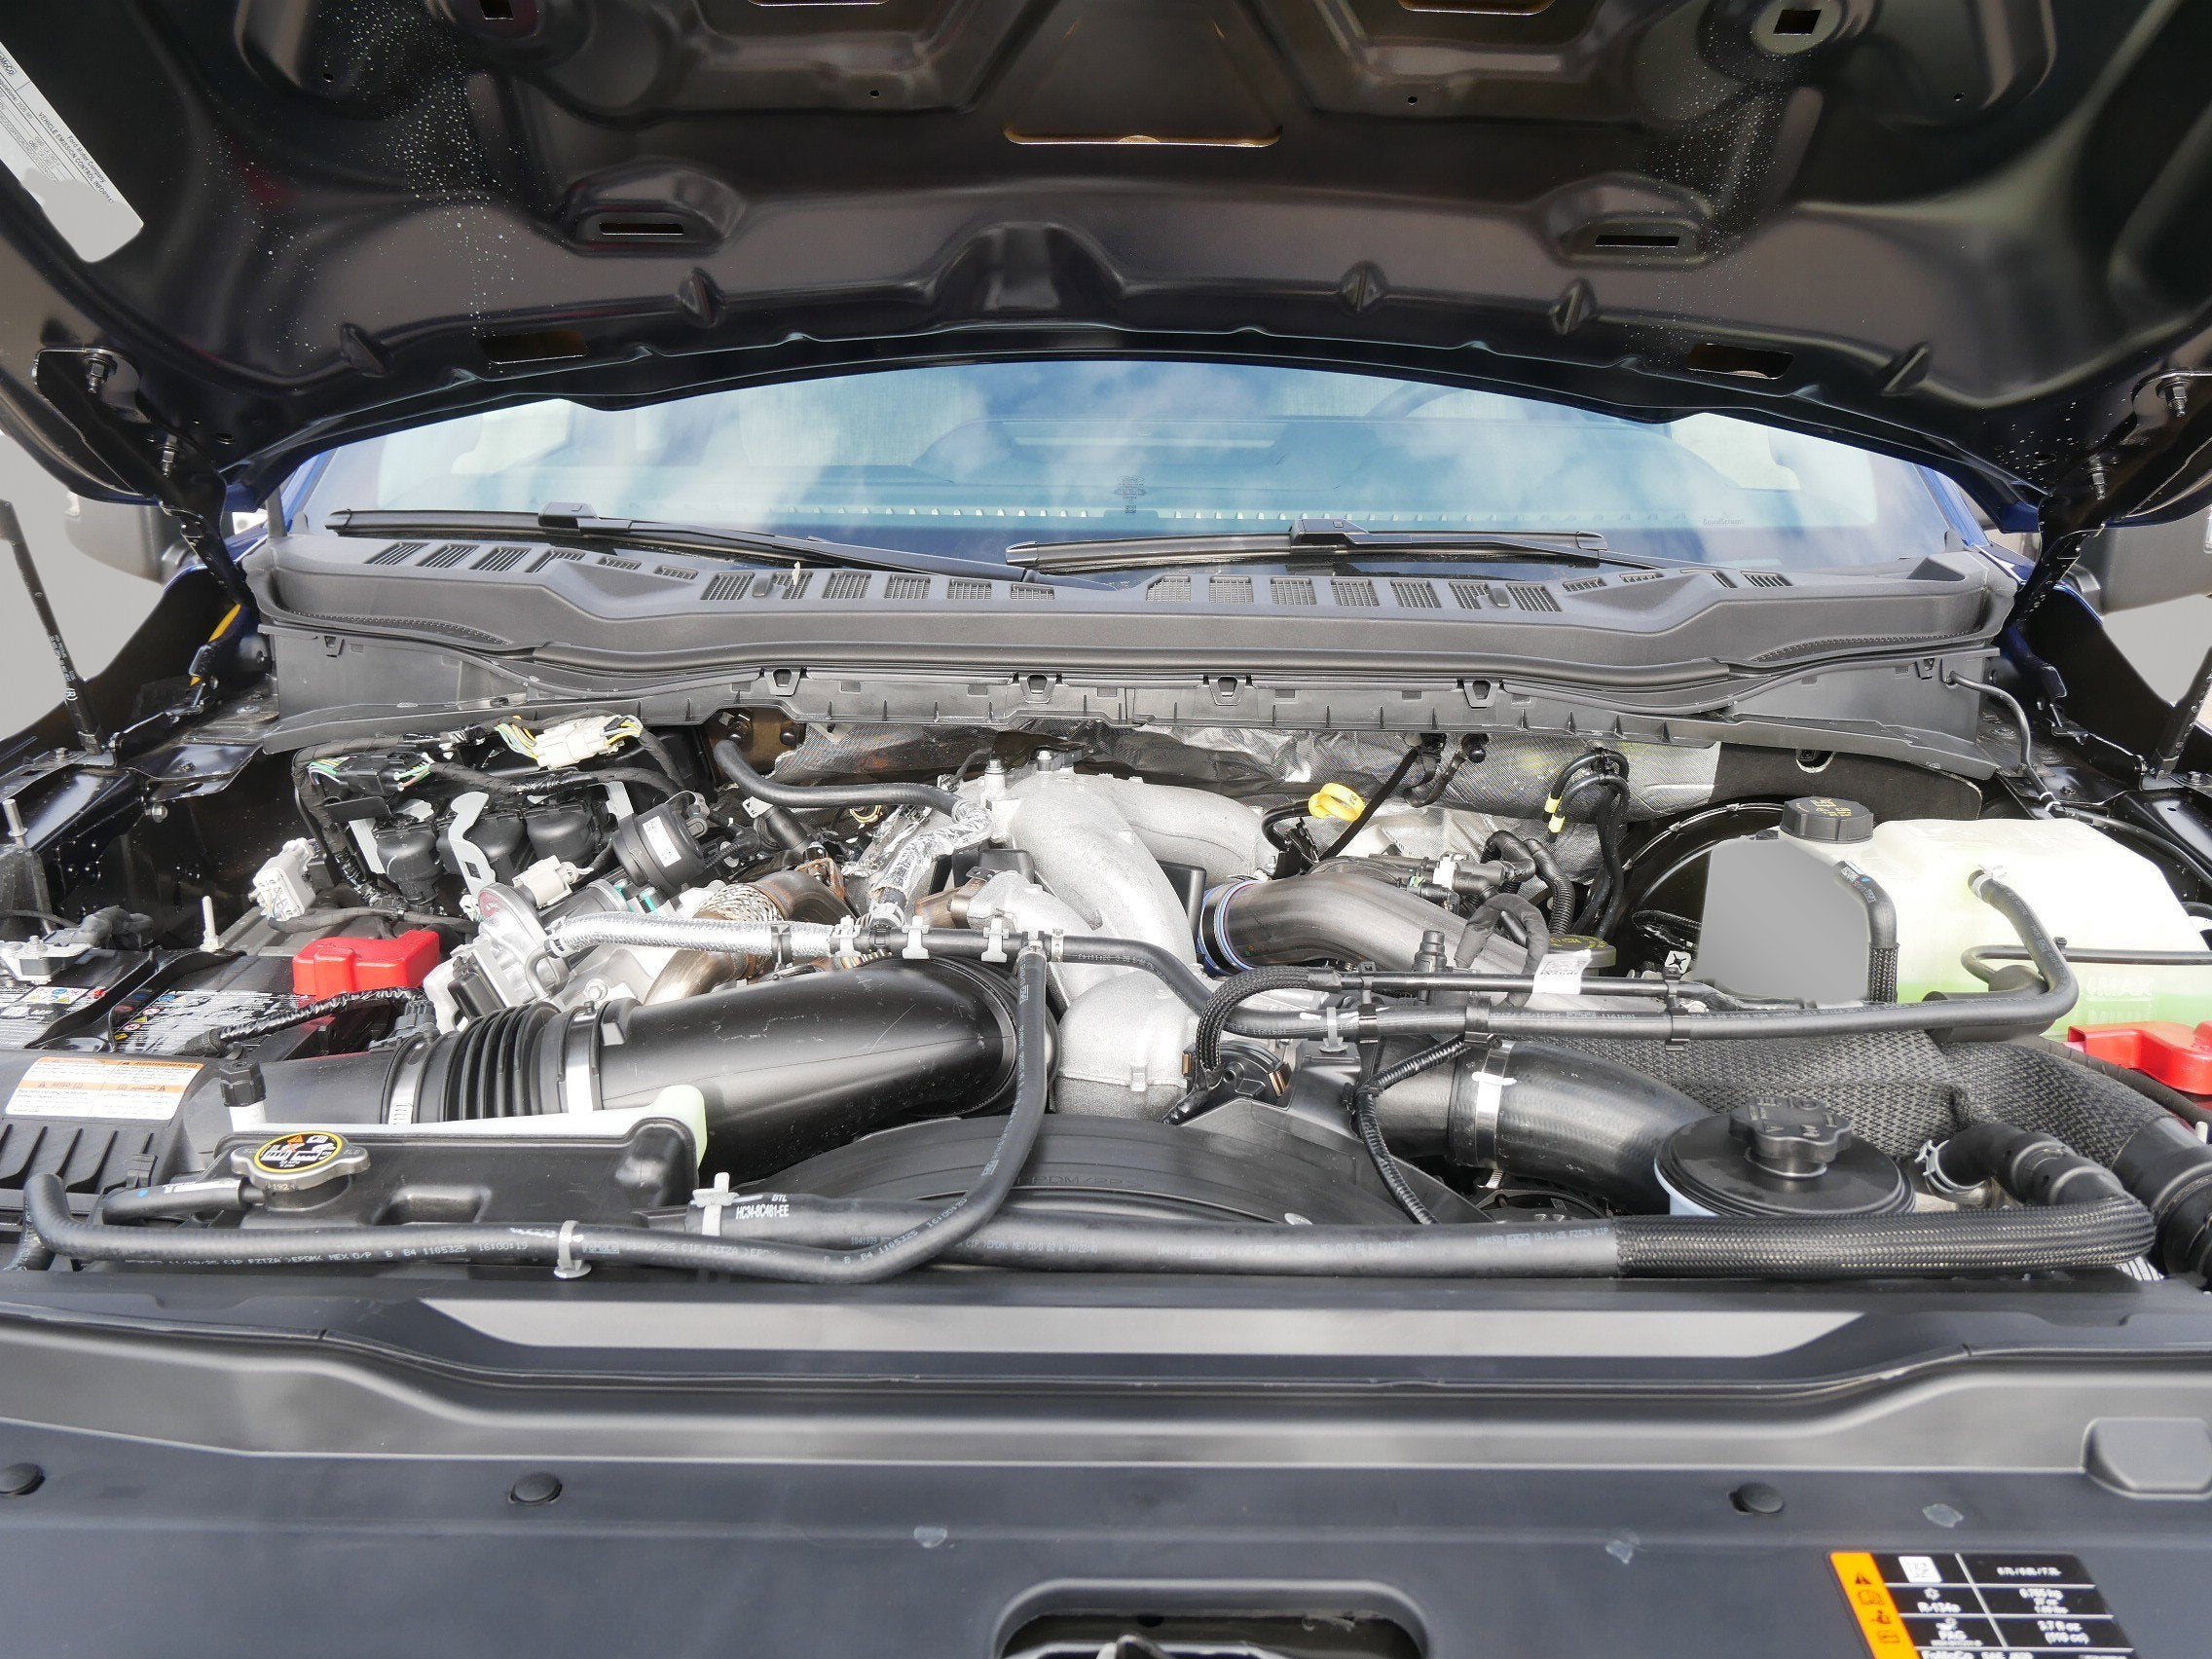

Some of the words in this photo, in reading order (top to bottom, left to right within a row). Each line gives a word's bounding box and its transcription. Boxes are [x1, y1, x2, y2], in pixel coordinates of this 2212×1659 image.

[37, 111, 57, 134] VEHICLE
[55, 132, 77, 159] EMISSION
[74, 157, 95, 182] CONTROL
[66, 134, 79, 148] Ford
[76, 146, 89, 161] Motor
[86, 160, 106, 183] Company
[64, 687, 79, 701] (R)
[423, 1244, 467, 1255] 1105325
[1917, 1602, 1961, 1613] R-134a
[1937, 1630, 1968, 1641] PAG
